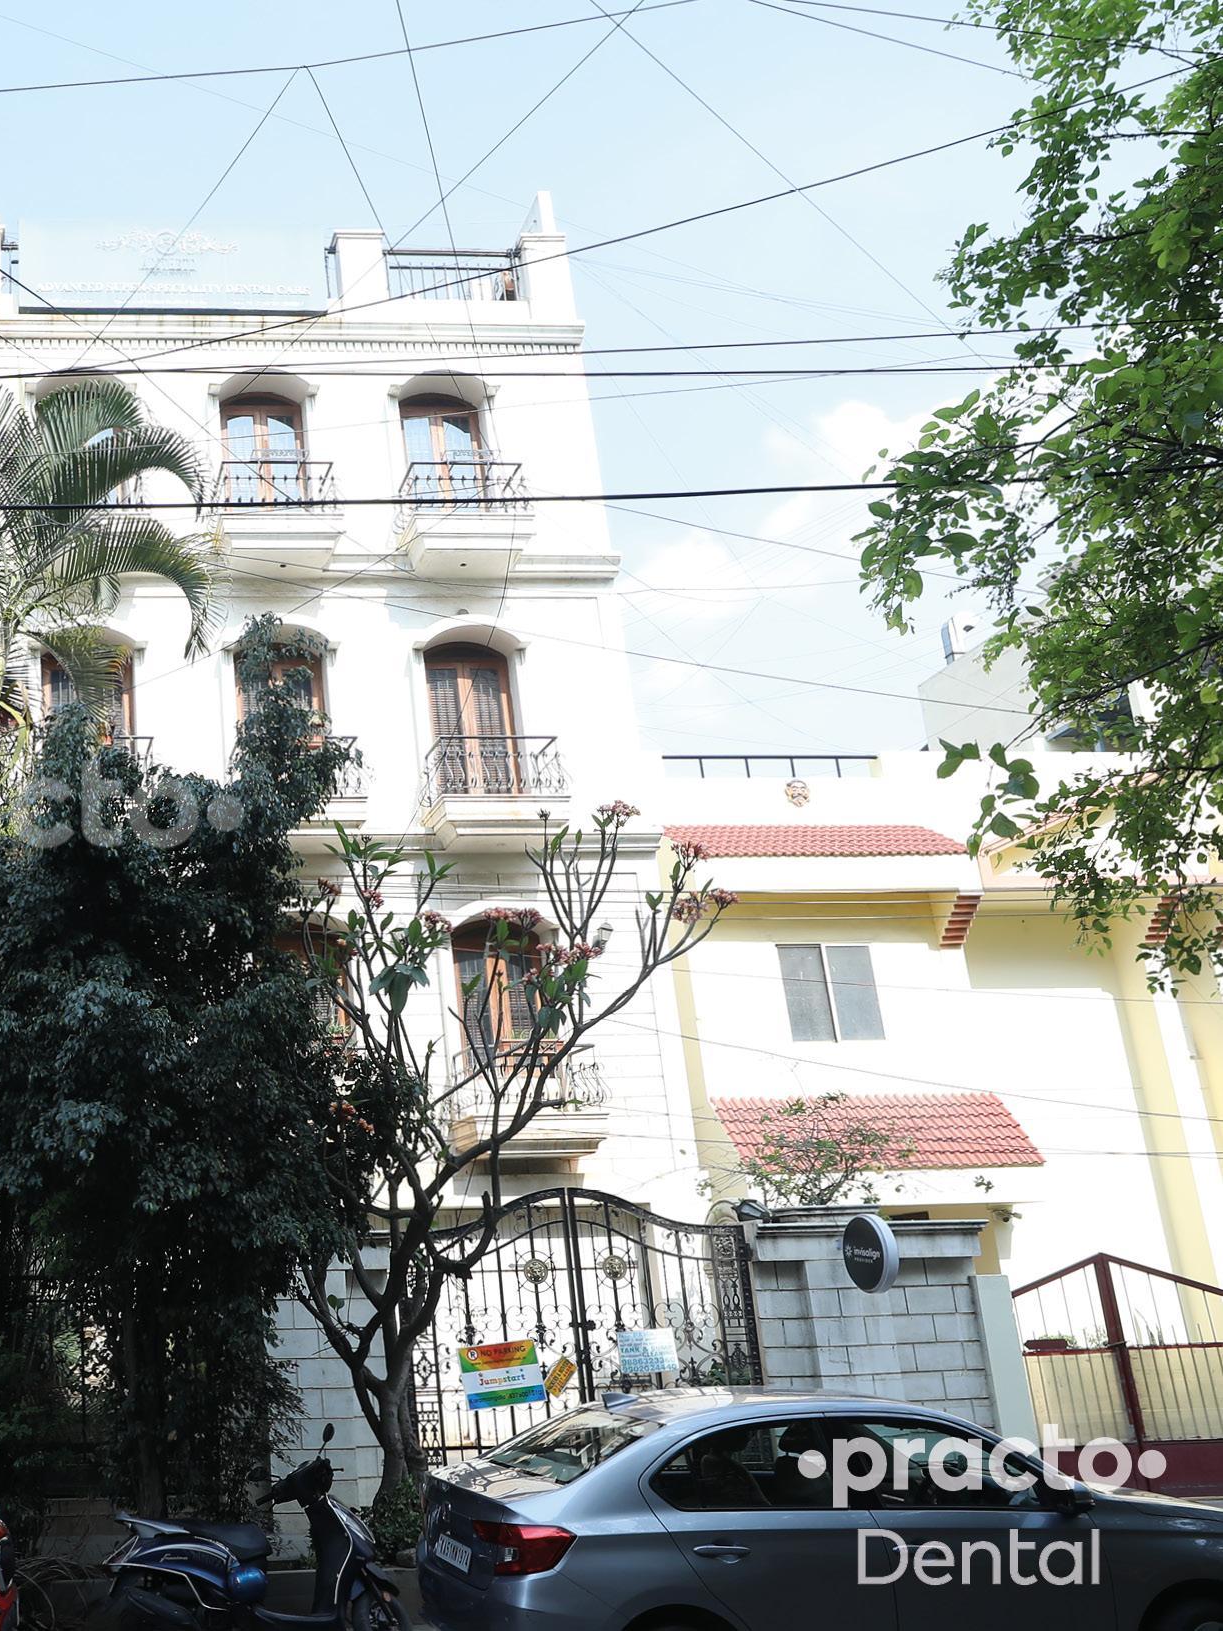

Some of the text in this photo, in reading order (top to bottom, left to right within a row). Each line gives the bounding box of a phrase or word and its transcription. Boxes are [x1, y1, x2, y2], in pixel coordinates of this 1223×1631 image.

[853, 1246, 880, 1260] invisalign
[481, 1345, 526, 1357] NO PARKING
[479, 1374, 526, 1386] Jumpstart
